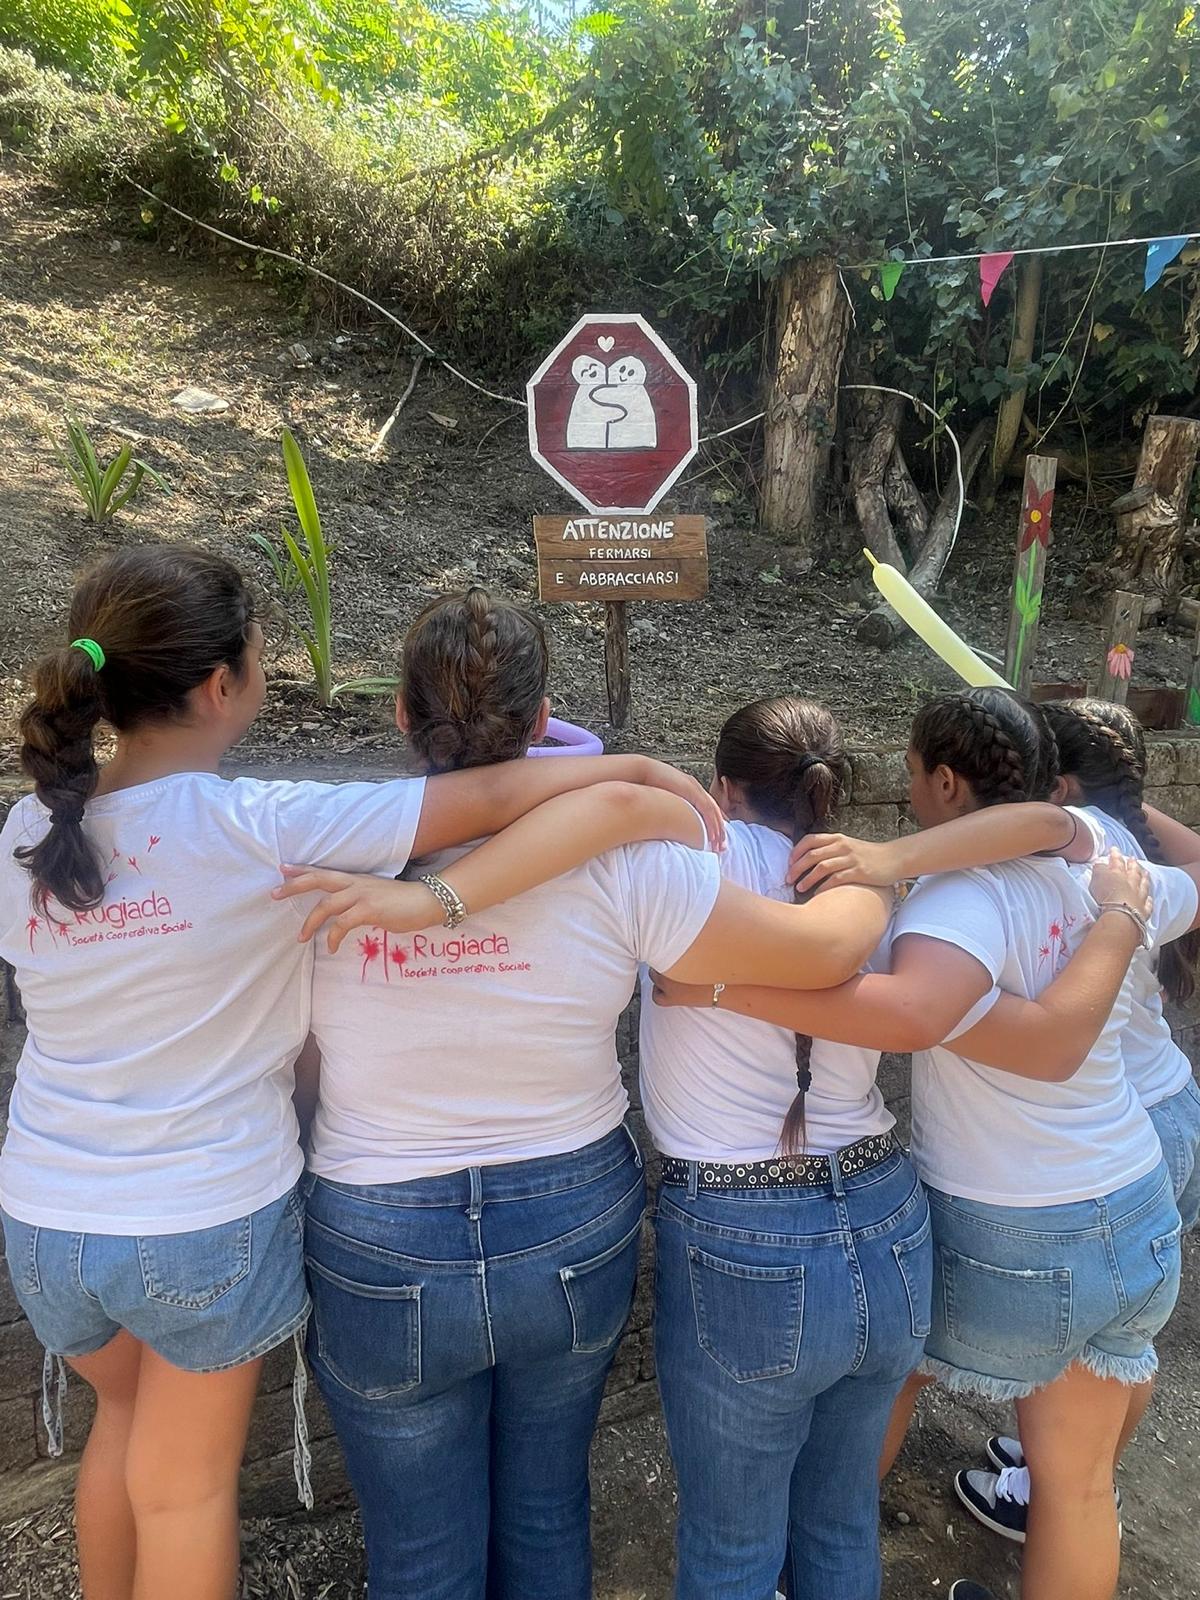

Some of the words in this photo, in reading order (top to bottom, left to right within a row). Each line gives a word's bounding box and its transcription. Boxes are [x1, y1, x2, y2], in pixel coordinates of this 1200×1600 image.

[562, 518, 674, 540] ATTENZIONE
[589, 548, 651, 559] FERMARSI
[556, 573, 564, 584] E
[579, 571, 679, 586] ABBRACCIARSI
[72, 931, 104, 946] Società
[105, 927, 159, 941] Cooperativa
[161, 920, 193, 935] Sociale
[414, 932, 510, 963] Rugiada
[498, 962, 532, 972] Sociale
